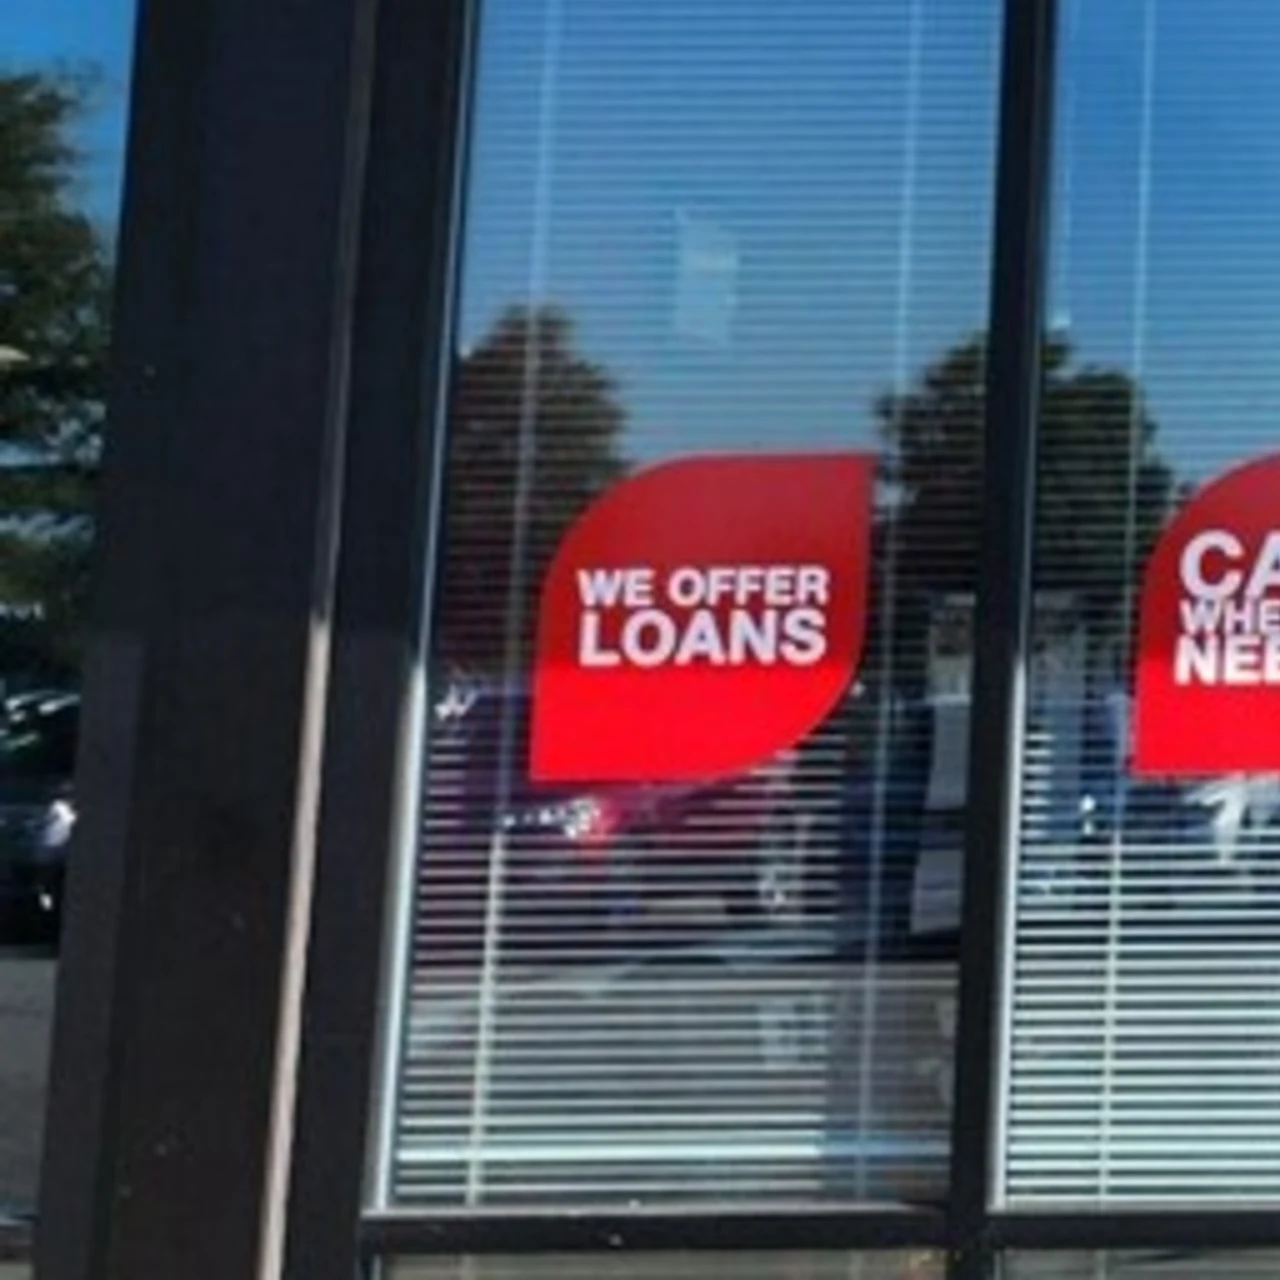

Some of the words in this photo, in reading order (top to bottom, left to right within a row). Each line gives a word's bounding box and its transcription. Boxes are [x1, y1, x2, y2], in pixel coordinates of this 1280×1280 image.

[577, 568, 654, 607] WE
[668, 566, 830, 607] OFFER
[578, 608, 827, 667] LOANS
